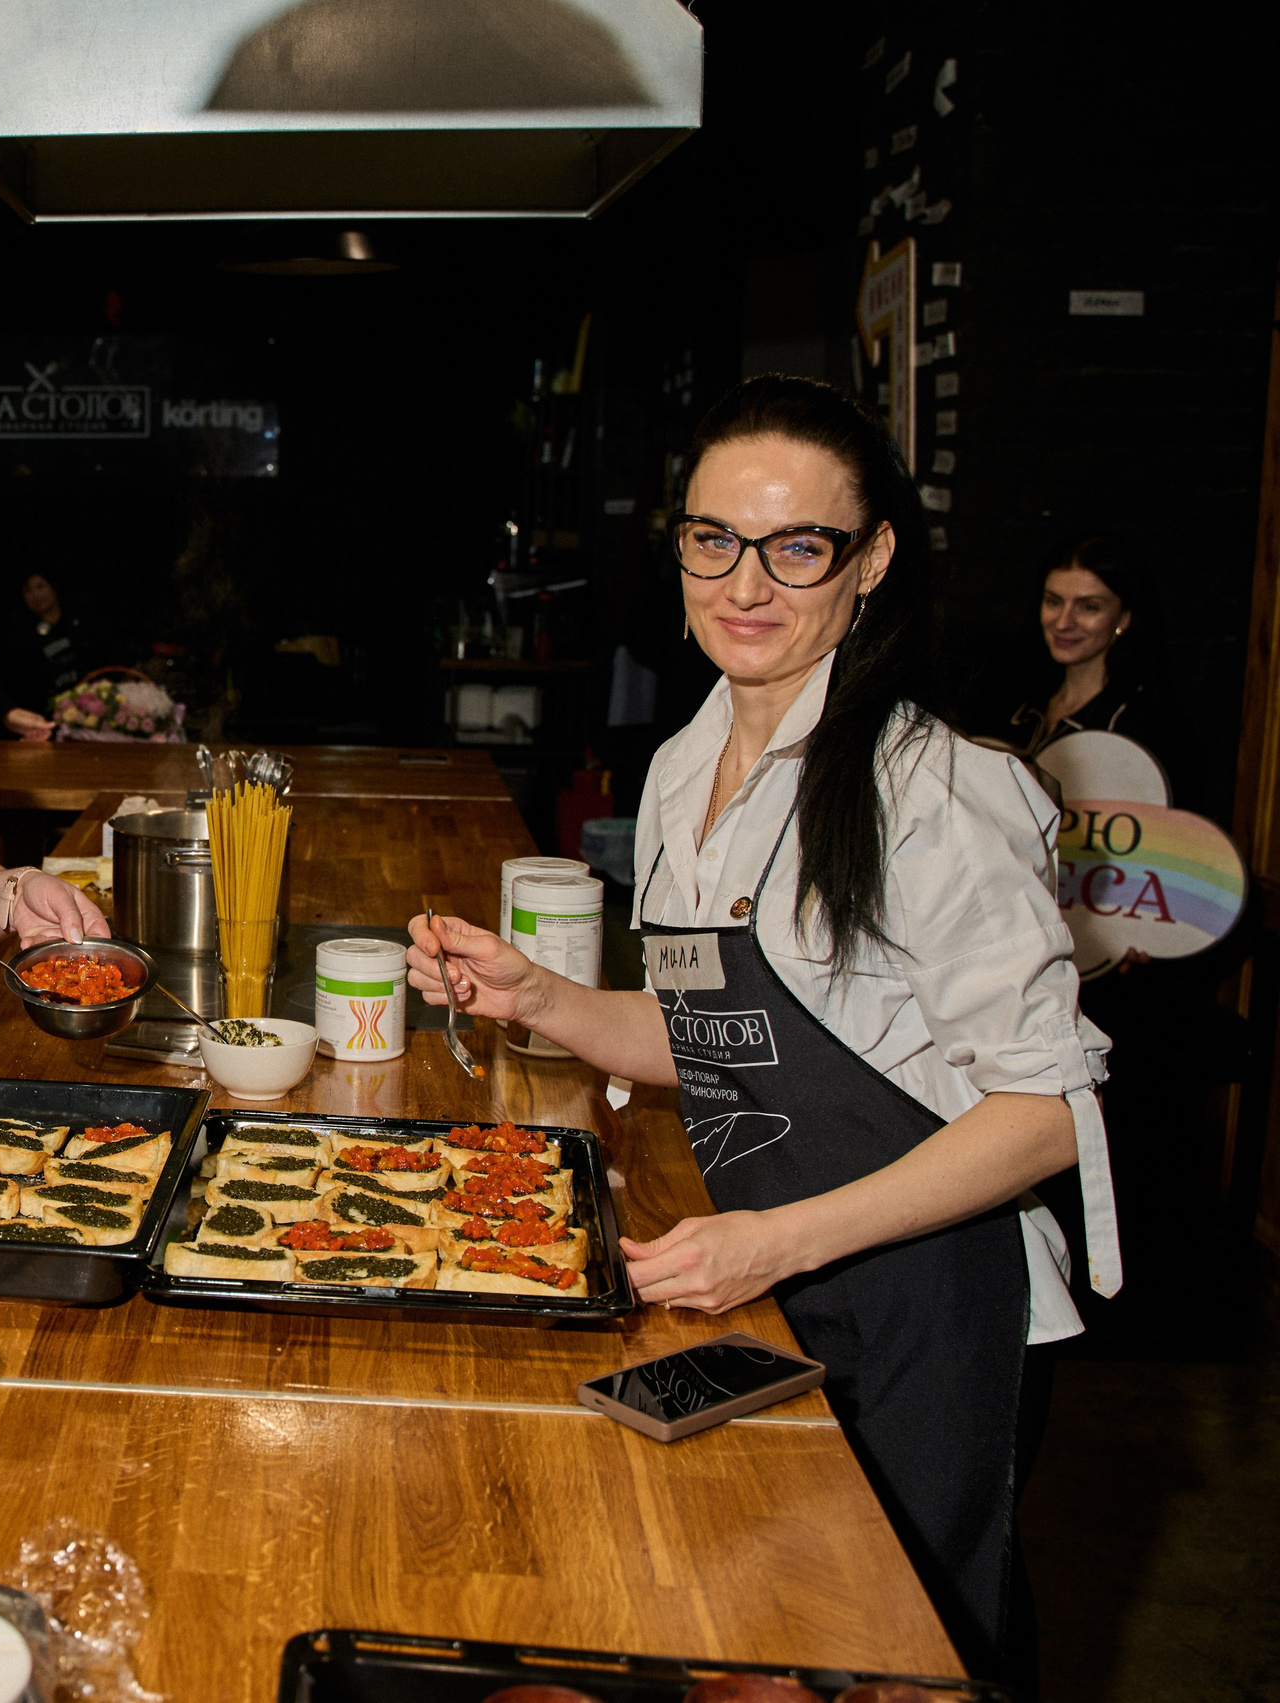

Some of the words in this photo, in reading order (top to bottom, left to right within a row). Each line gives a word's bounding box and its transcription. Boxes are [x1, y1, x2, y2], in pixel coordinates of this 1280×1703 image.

[21, 392, 141, 421] СТОЛОВ
[162, 401, 264, 432] körting
[670, 1014, 764, 1047] СТОЛОВ
[690, 1084, 739, 1102] ВИНОКУРОВ
